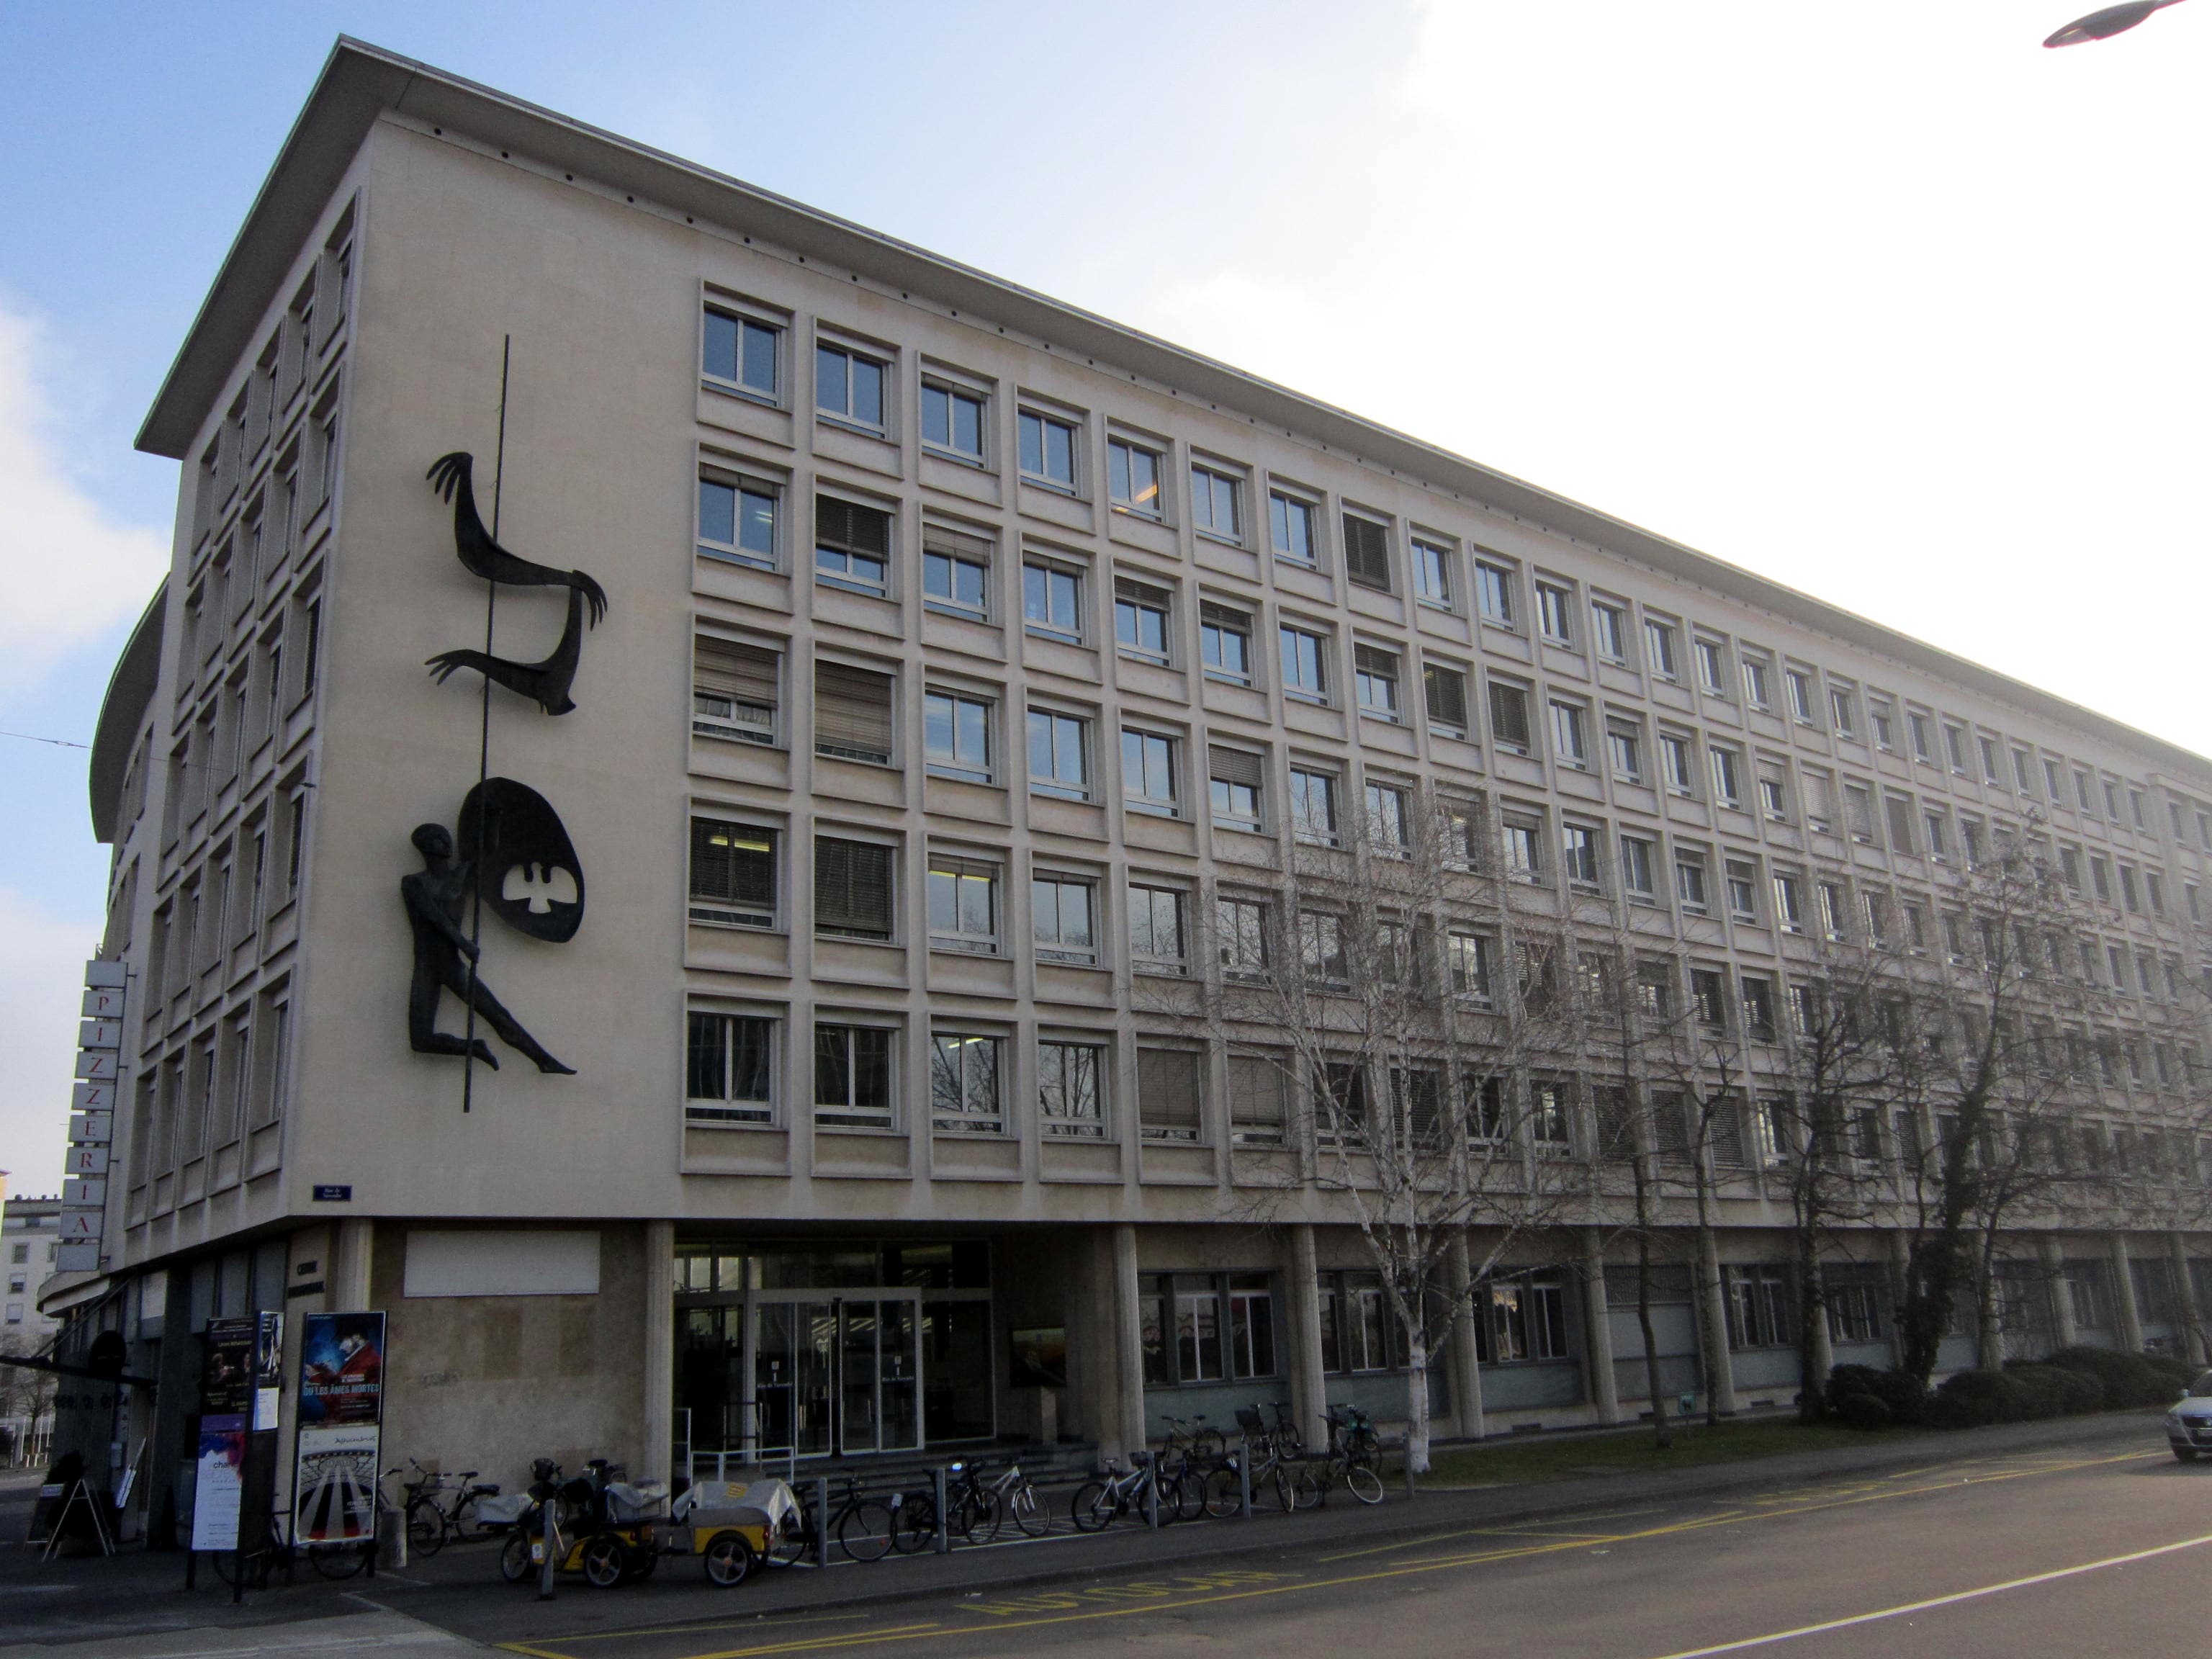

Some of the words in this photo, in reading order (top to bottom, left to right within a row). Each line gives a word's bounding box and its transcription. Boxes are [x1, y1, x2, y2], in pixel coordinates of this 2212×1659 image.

[73, 996, 110, 1233] PIZZERIA
[315, 1386, 329, 1395] LES
[351, 1382, 380, 1394] MORTES
